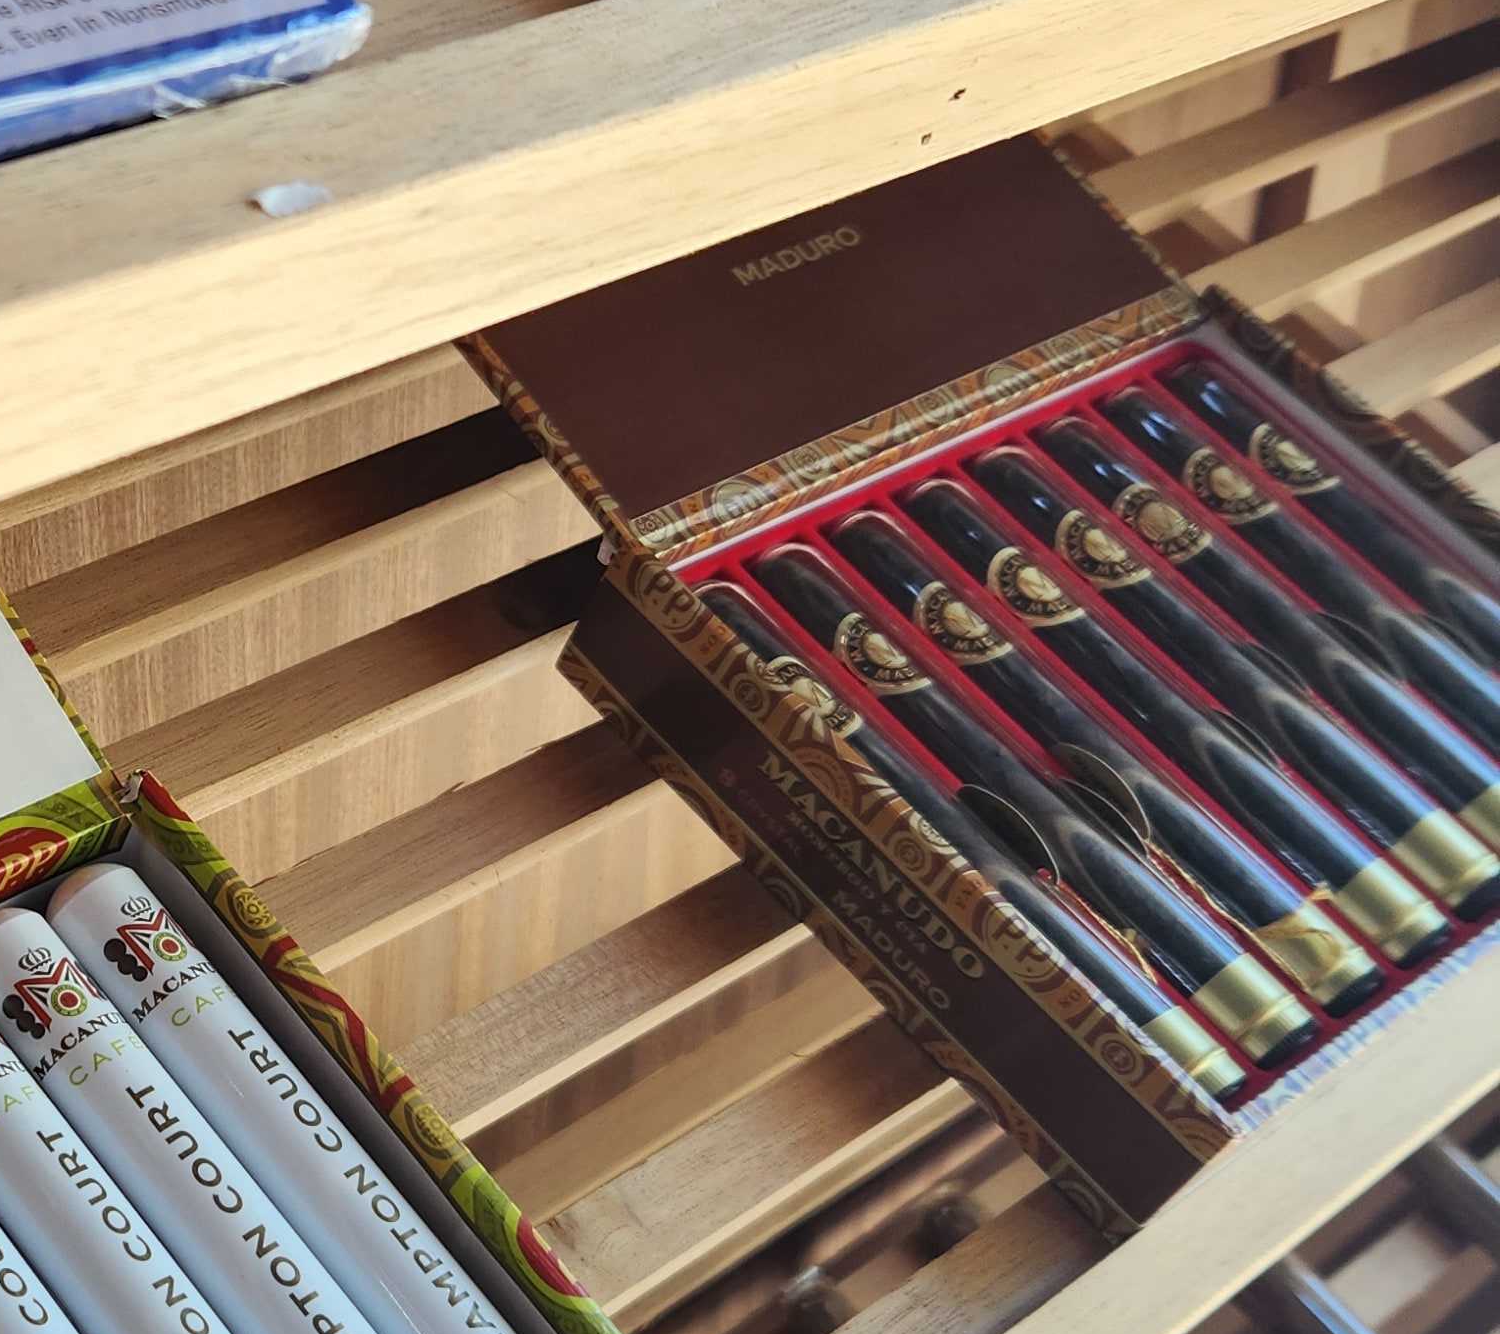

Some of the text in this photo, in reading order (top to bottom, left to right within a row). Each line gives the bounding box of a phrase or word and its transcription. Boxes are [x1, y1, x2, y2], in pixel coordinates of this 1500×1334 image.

[11, 19, 73, 54] Even
[74, 11, 101, 40] In
[731, 225, 863, 288] MADURO
[757, 750, 985, 980] MACANUDO
[171, 984, 238, 1028] CAF
[831, 889, 952, 1012] MADURO
[124, 1082, 244, 1215] COURT
[226, 1025, 343, 1154] COURT
[35, 1128, 154, 1263] COURT
